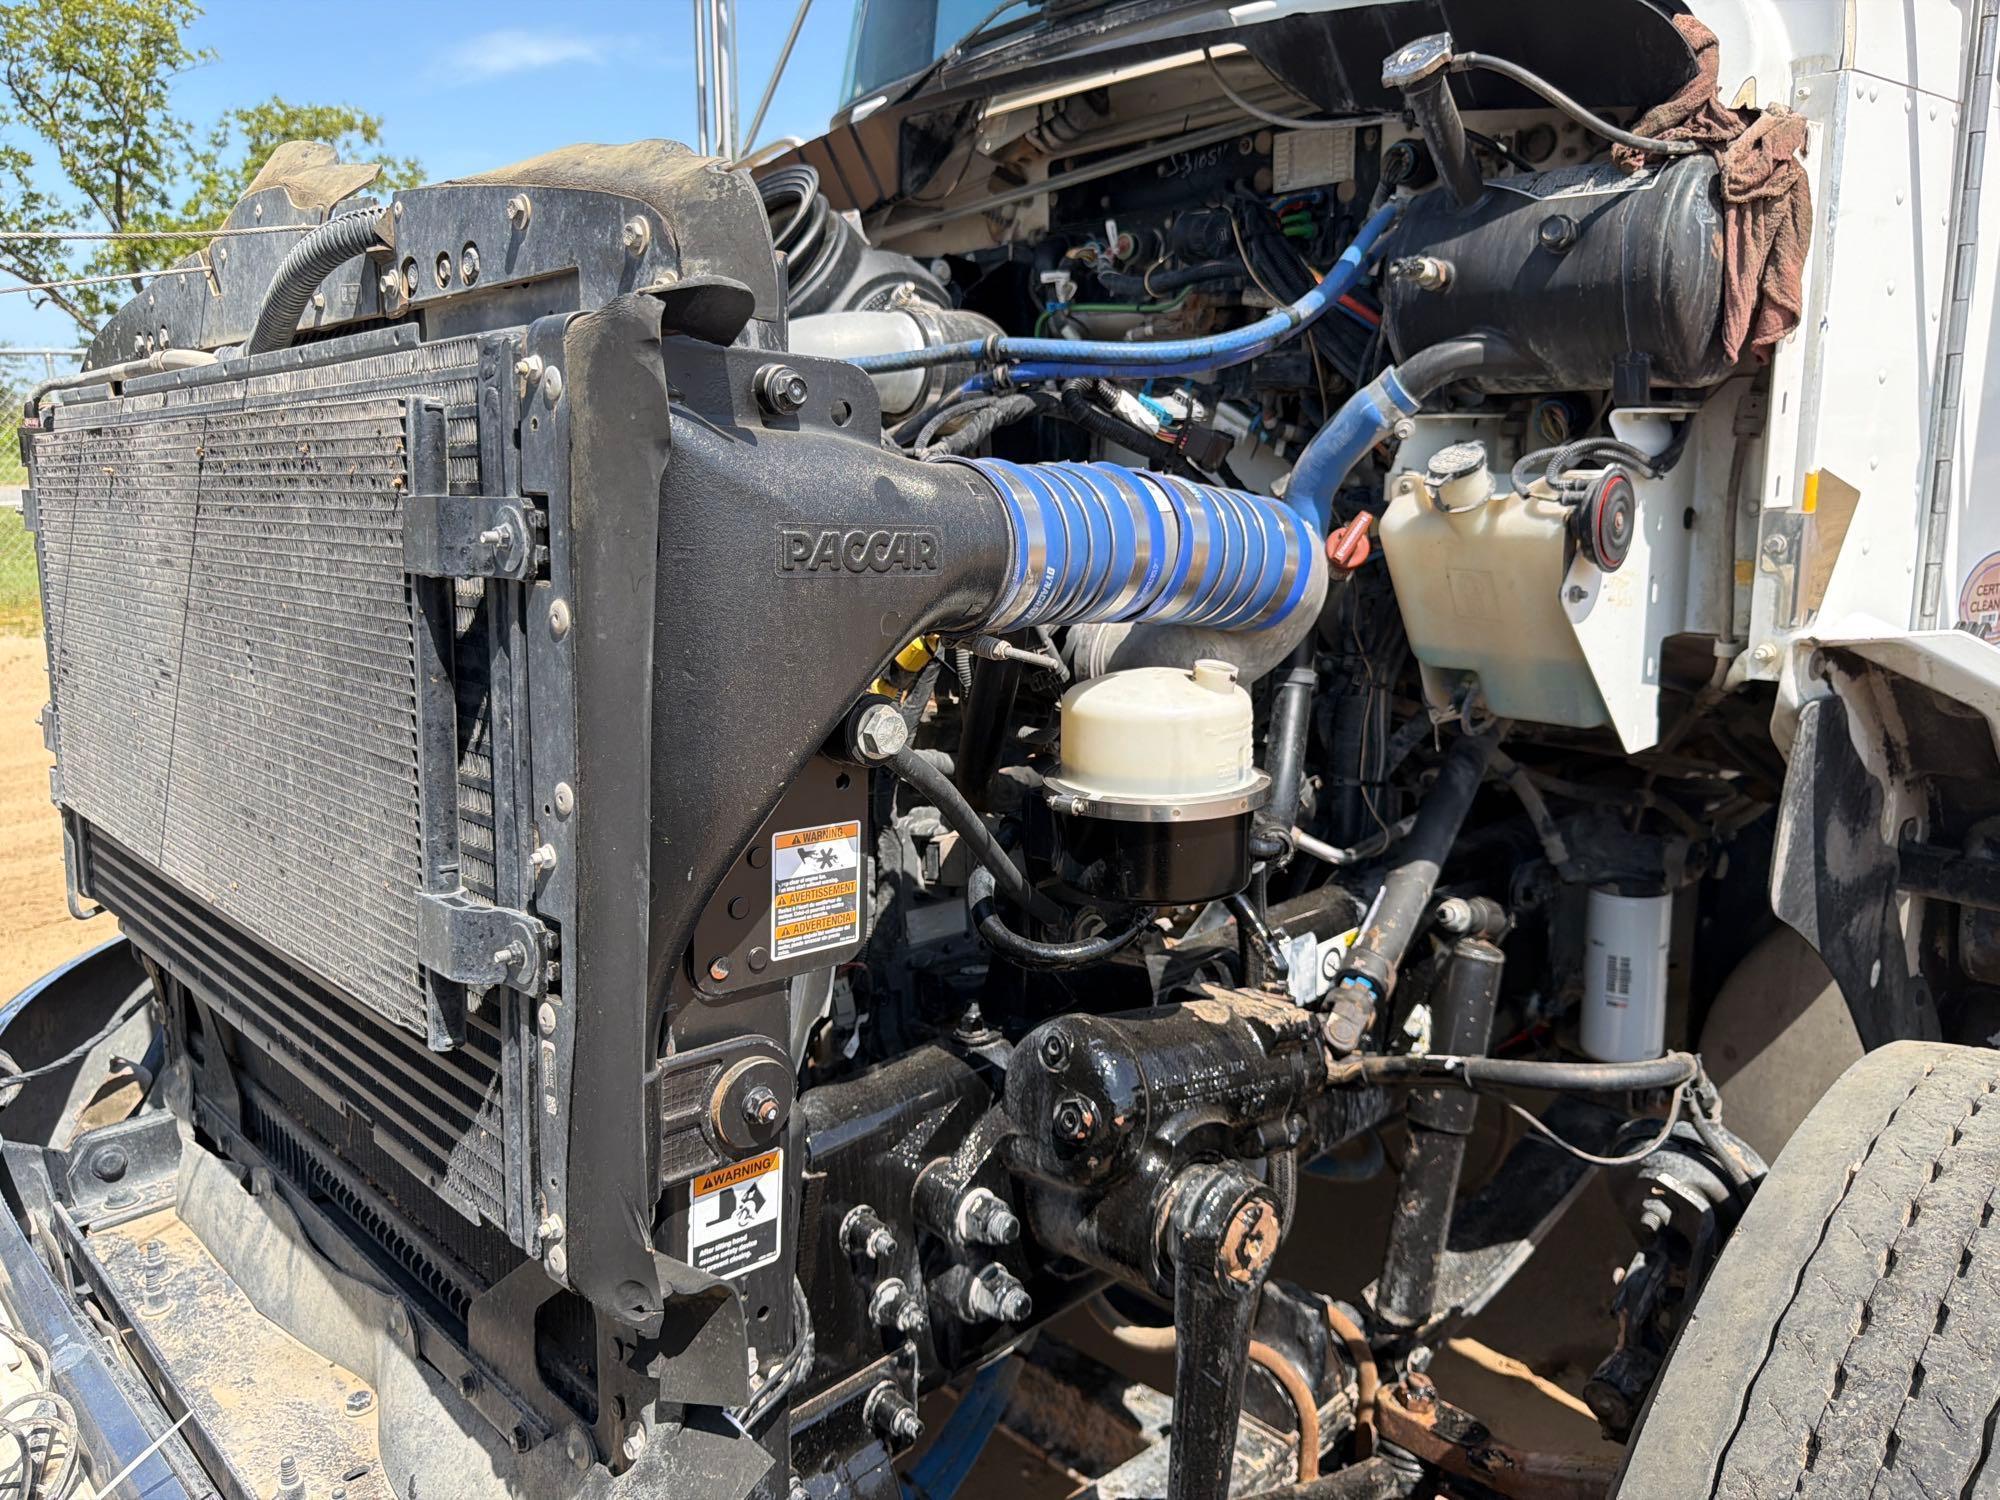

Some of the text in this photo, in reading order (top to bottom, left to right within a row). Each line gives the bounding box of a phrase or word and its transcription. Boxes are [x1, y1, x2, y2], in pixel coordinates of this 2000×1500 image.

[782, 530, 937, 573] PACCAR
[803, 827, 843, 843] WARNING
[789, 882, 855, 904] AVERTISSEMENT
[793, 913, 852, 934] ADVERTENCIA
[713, 1158, 771, 1186] WARNING
